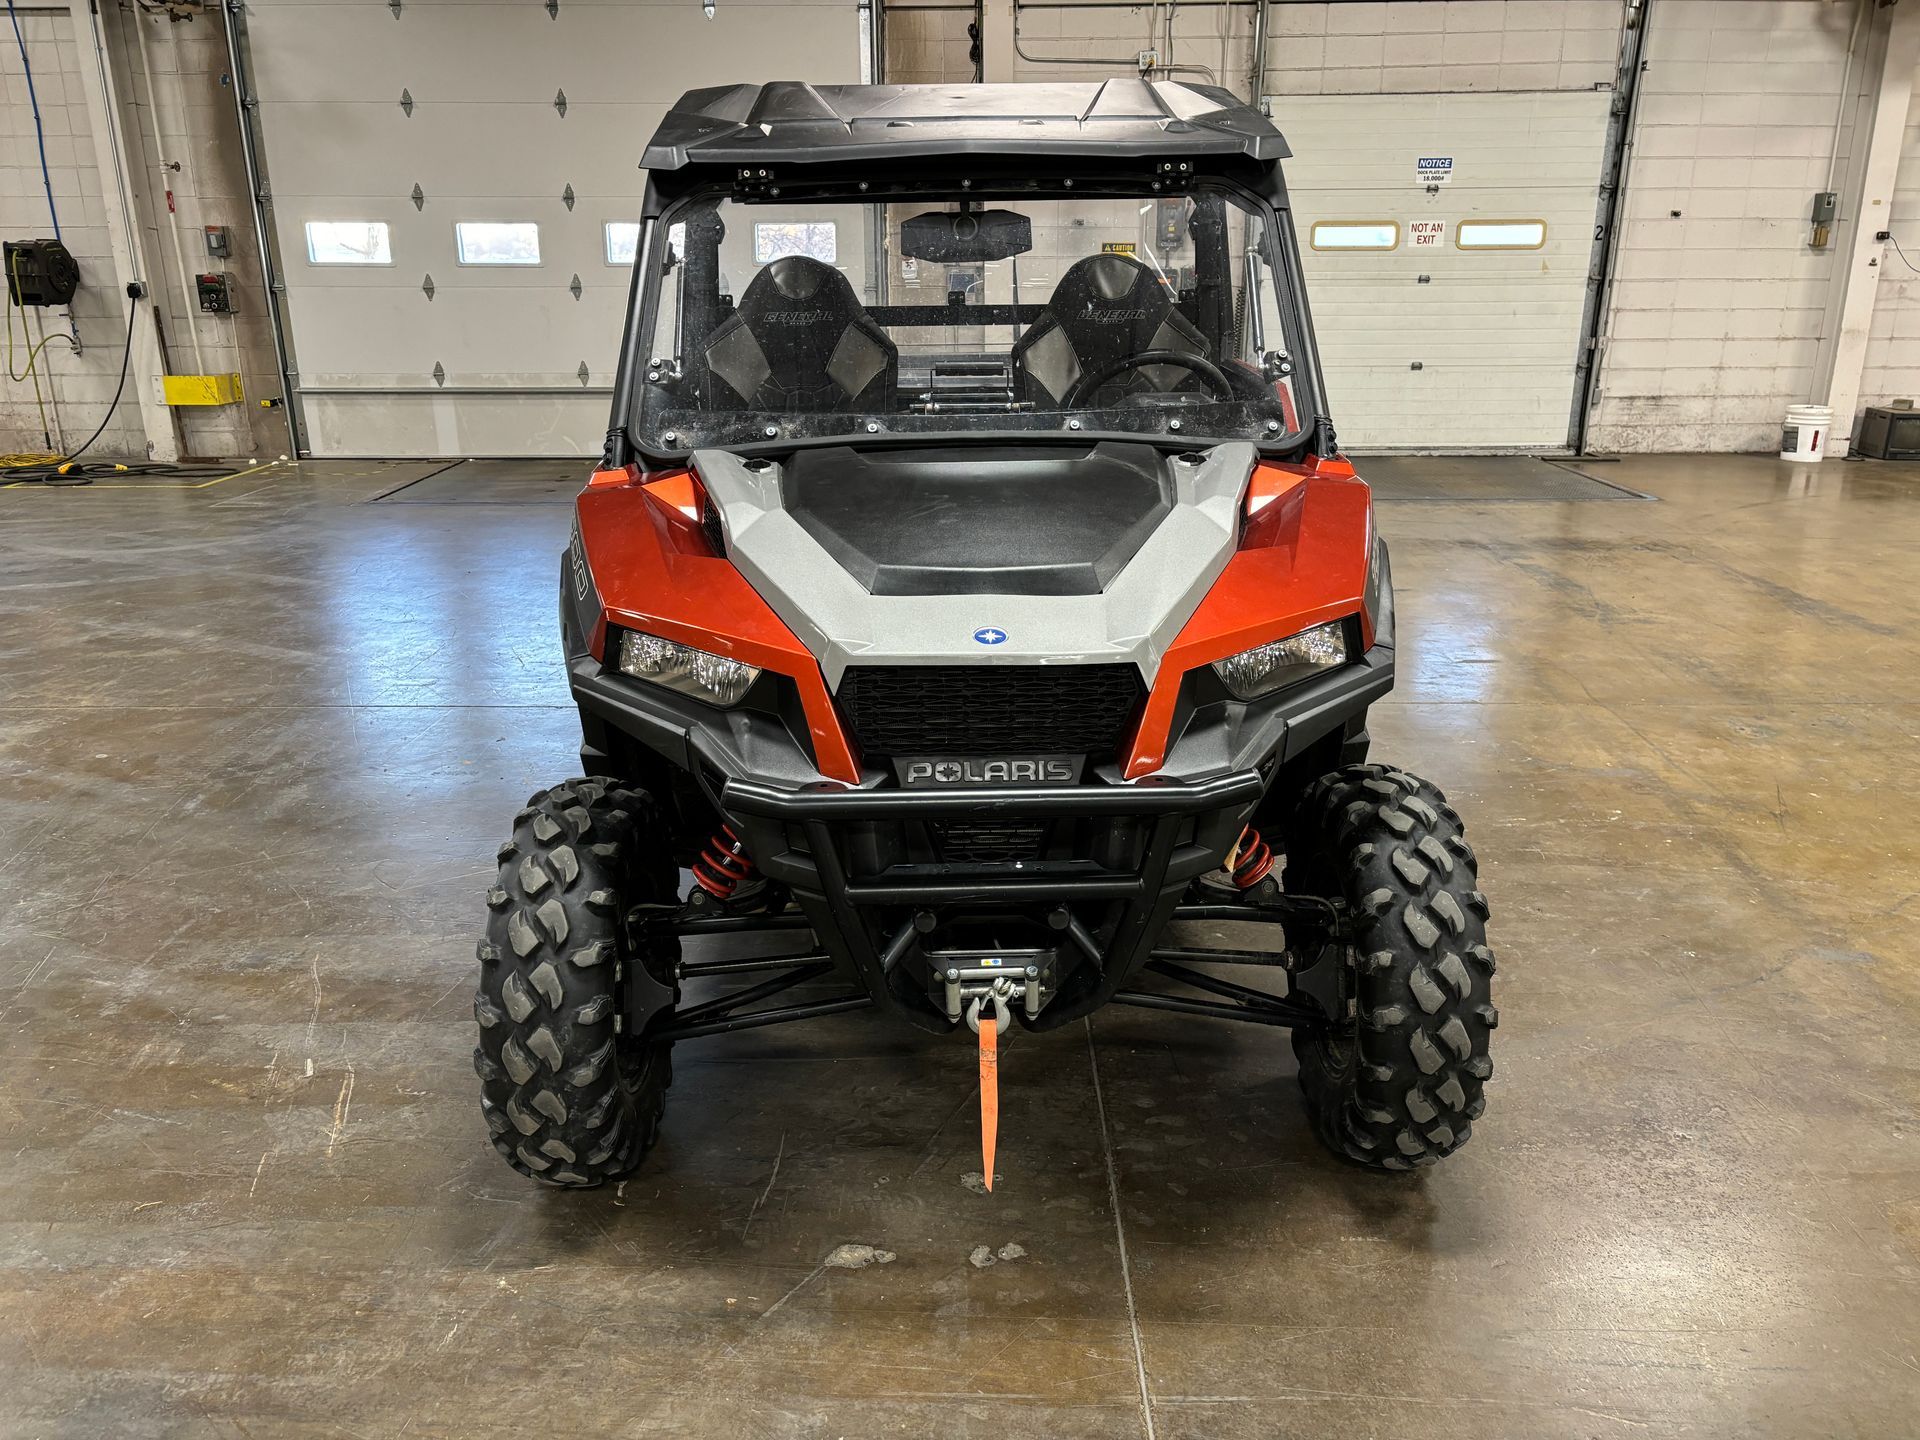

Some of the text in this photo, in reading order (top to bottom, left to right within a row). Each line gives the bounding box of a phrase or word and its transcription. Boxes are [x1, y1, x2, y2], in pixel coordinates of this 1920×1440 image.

[1420, 159, 1451, 168] NOTICE
[1411, 223, 1444, 233] NOT AN
[1594, 224, 1604, 241] 2
[1416, 235, 1436, 245] EXIT
[1112, 244, 1134, 252] CAUTION
[763, 311, 834, 322] GENERAL
[1077, 309, 1146, 320] GENERAL
[907, 760, 1073, 783] POLARIS
